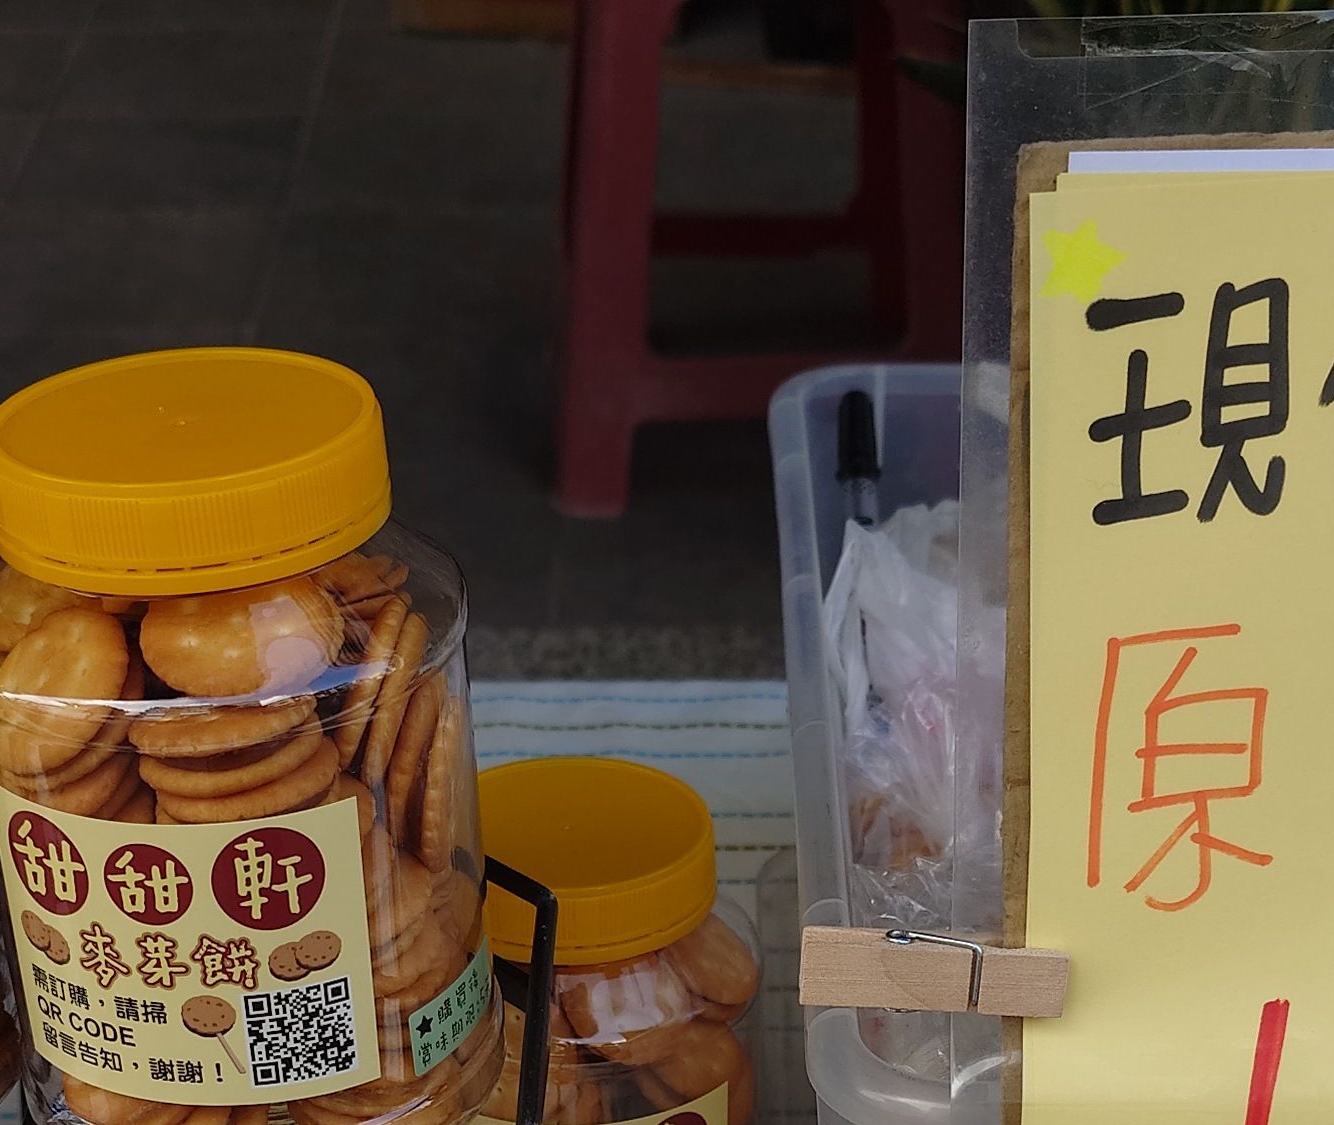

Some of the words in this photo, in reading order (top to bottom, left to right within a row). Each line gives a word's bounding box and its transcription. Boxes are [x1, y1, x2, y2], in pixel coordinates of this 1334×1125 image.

[12, 819, 314, 920] 甜甜軒
[78, 921, 261, 990] 麥芽餅
[37, 995, 65, 1025] QR
[68, 1012, 136, 1047] CODE
